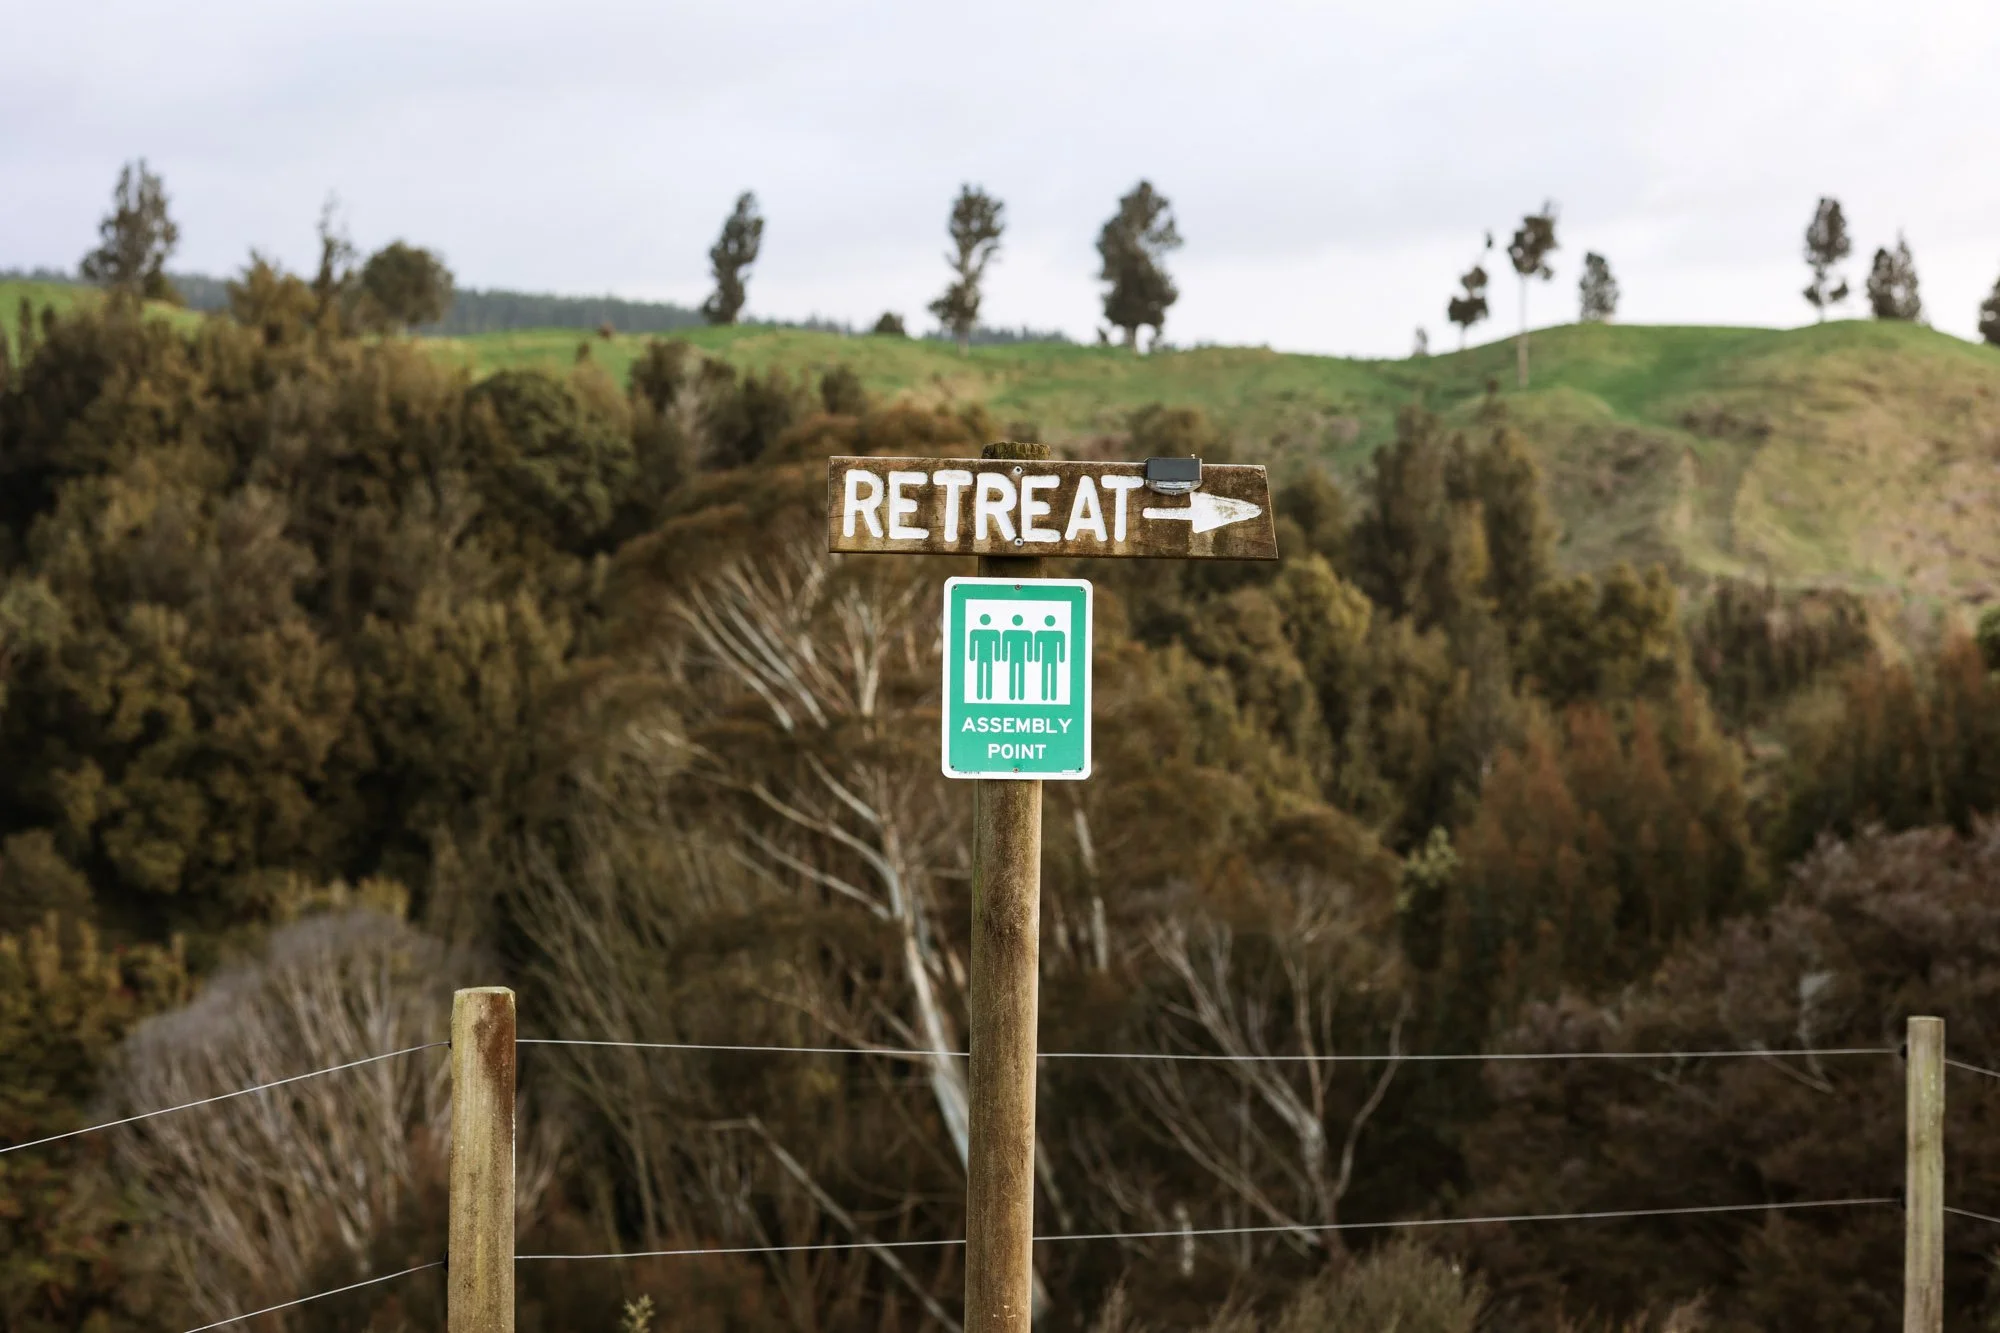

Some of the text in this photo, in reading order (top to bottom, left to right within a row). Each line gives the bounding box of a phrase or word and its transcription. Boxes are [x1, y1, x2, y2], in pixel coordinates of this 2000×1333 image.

[842, 469, 1144, 542] RETREAT
[961, 716, 1072, 734] ASSEMBLY
[988, 743, 1046, 759] POINT
